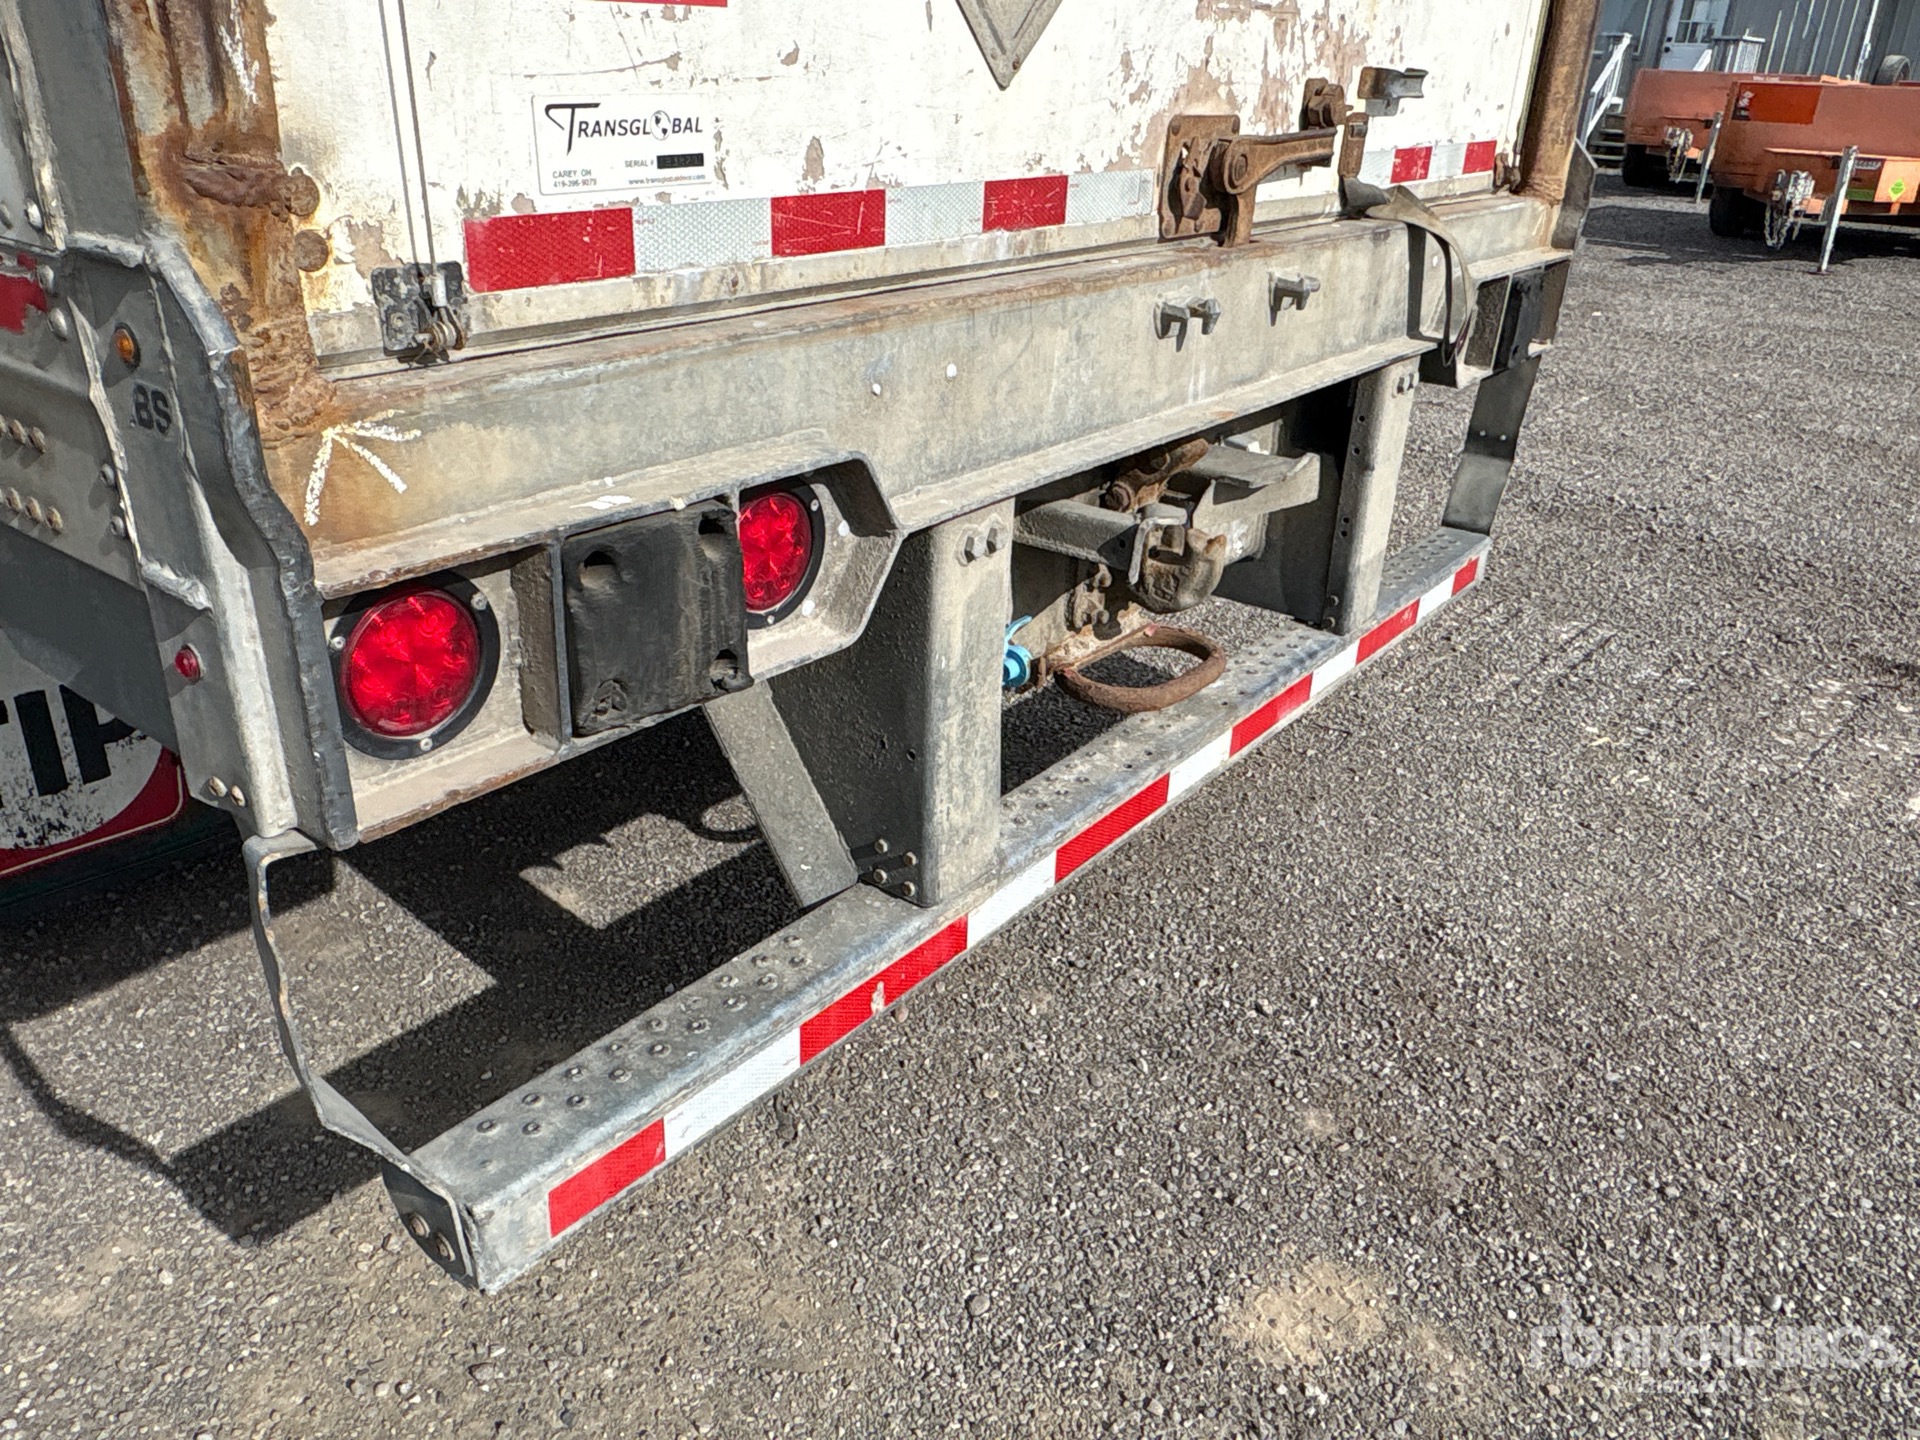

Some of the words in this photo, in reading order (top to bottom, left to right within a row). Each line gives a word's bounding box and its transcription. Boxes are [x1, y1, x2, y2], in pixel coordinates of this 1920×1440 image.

[624, 159, 649, 168] SERIAL
[552, 169, 578, 179] CAREY
[580, 168, 592, 177] OH
[133, 383, 172, 434] BS
